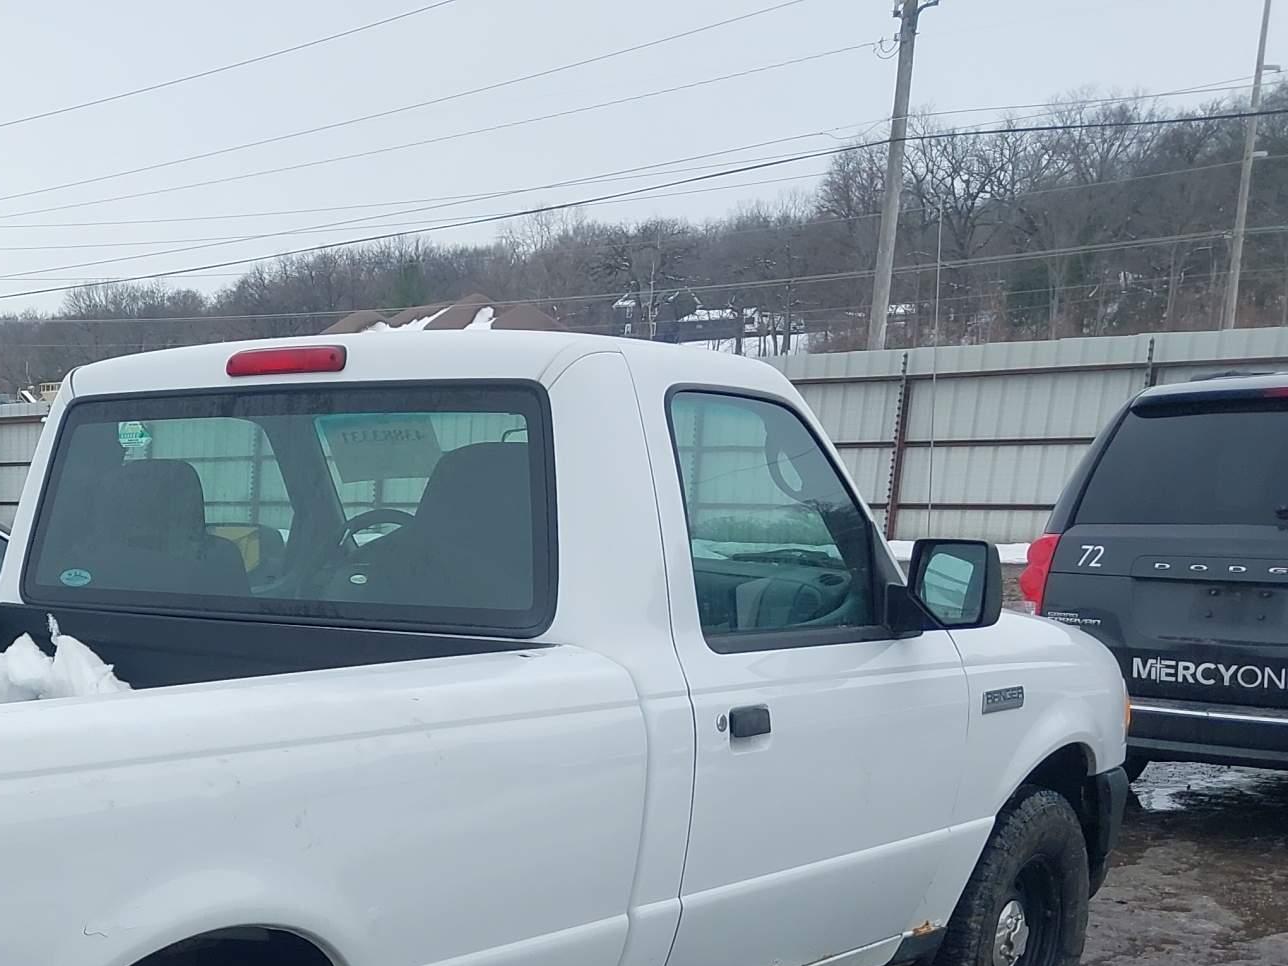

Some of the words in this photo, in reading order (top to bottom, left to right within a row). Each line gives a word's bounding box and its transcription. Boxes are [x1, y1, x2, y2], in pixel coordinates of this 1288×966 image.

[1078, 545, 1104, 566] 72
[1132, 656, 1288, 690] MERCYON
[985, 687, 1024, 705] RANGER
